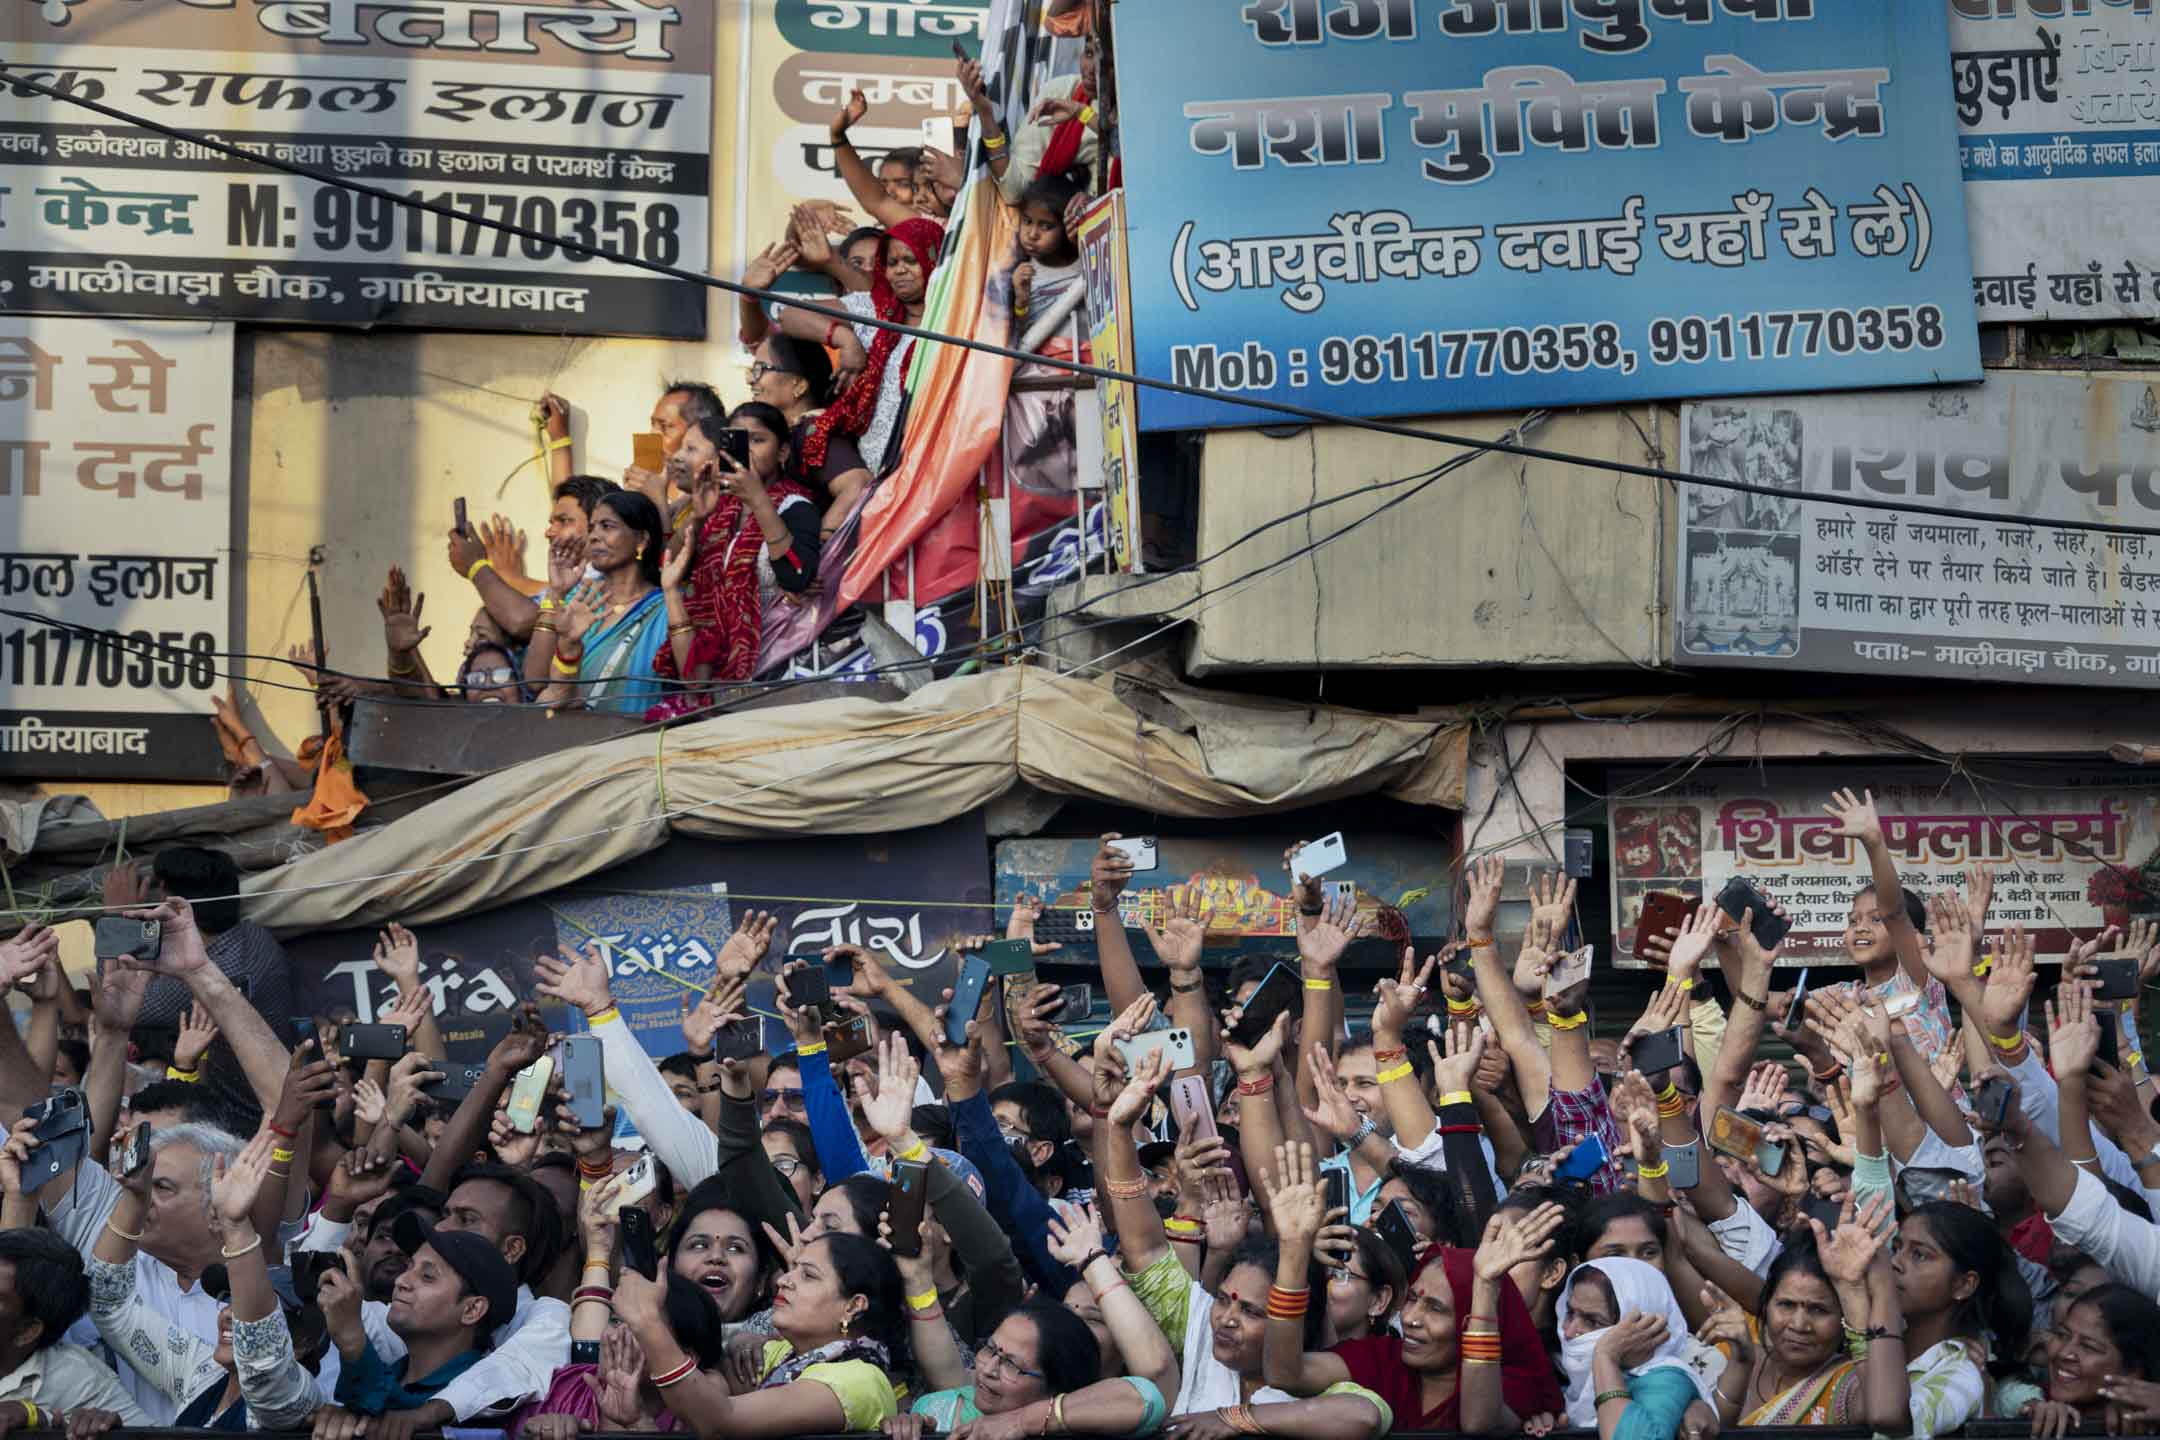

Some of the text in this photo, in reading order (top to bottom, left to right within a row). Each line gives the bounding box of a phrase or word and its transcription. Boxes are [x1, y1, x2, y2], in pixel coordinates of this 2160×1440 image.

[136, 69, 406, 113] सफल
[424, 81, 684, 130] इलाज
[800, 70, 968, 111] तम्बा
[1183, 54, 1890, 186] नशा मुक्ति केन्द्र
[274, 143, 325, 164] नशा
[330, 142, 393, 172] छुड़ाने
[399, 148, 432, 169] का
[438, 150, 506, 173] इलाज
[511, 154, 531, 174] व
[536, 152, 616, 179] परामर्श
[619, 154, 677, 184] केन्द्र
[1973, 139, 1998, 168] नशे
[2000, 146, 2020, 167] का
[2092, 143, 2129, 165] सफल
[2133, 141, 2160, 166] इला
[35, 176, 198, 235] केन्द्र
[312, 185, 680, 268] 9911770358
[1494, 195, 1645, 275] दवाई
[1655, 188, 1774, 268] यहाँ
[1777, 187, 1838, 261] से
[1847, 182, 1932, 272] ले)
[28, 260, 589, 312] मालीवाड़ा चौक, गाजियाबाद
[2047, 259, 2103, 306] यहाँ
[2112, 259, 2141, 303] से
[1171, 340, 1276, 393] Mob
[1319, 321, 1638, 386] 9811770358,
[1649, 304, 1946, 365] 9911770358
[87, 339, 177, 414] से
[73, 423, 215, 501] दर्द
[1815, 512, 1856, 541] हमारे
[1866, 514, 1899, 544] यहाँ
[1906, 524, 1986, 550] जयमाला,
[87, 555, 218, 607] इलाज
[1816, 549, 1864, 577] ऑर्डर
[1872, 551, 1900, 581] देने
[1908, 559, 1932, 580] पर
[1940, 553, 1984, 583] तैयार
[1993, 557, 2032, 585] किये
[2041, 560, 2077, 588] जाते
[1813, 591, 1829, 610] व
[1834, 592, 1873, 613] माता
[1877, 594, 1904, 616] का
[1908, 597, 1938, 621] द्वार
[1942, 592, 1973, 627] पूरी
[1976, 600, 2012, 624] तरह
[2130, 600, 2146, 628] से
[0, 628, 216, 690] 11770358
[1934, 642, 2047, 674] मालीवाड़ा
[2052, 647, 2118, 675] चौक,
[0, 717, 149, 755] ाजियाबाद
[1715, 798, 1853, 865] शिव
[1936, 871, 1967, 887] गाड़ी
